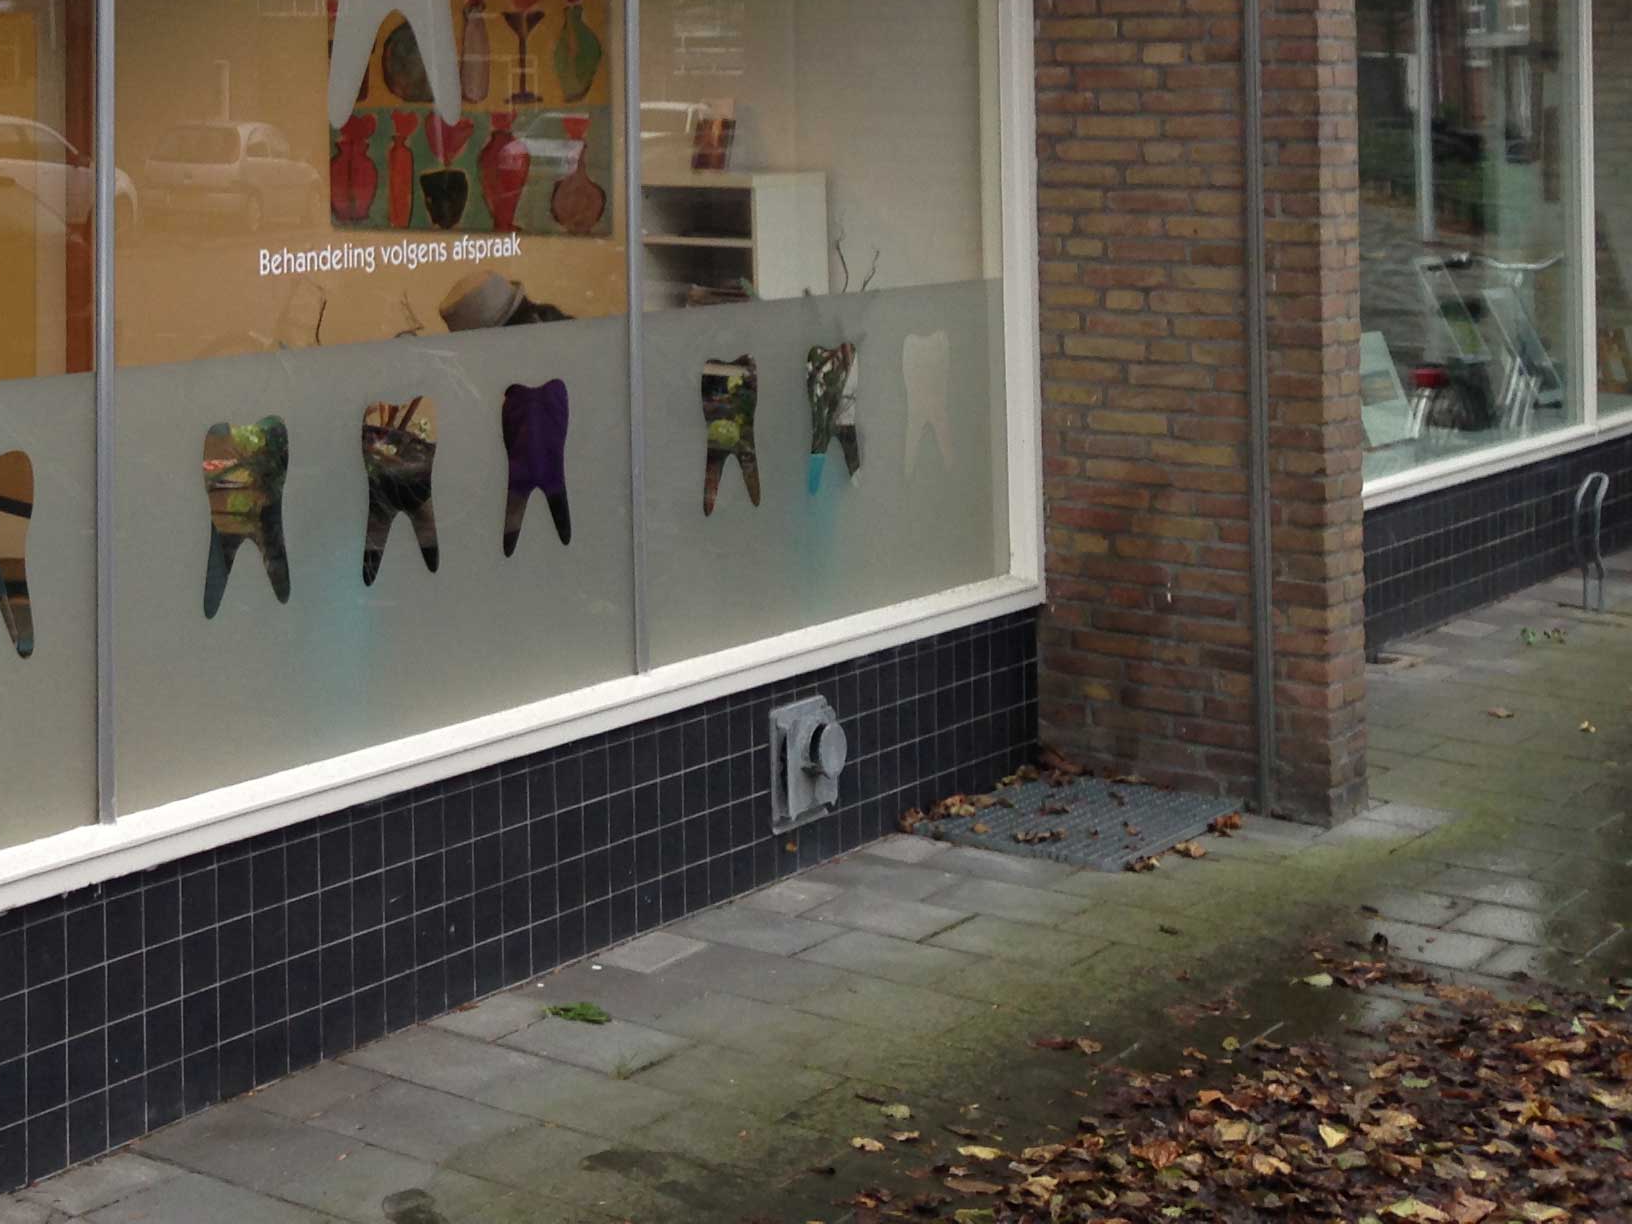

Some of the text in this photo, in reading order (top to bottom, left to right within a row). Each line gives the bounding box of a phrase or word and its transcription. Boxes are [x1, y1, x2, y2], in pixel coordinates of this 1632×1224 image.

[259, 232, 522, 275] Behandeling volgens afspraak
